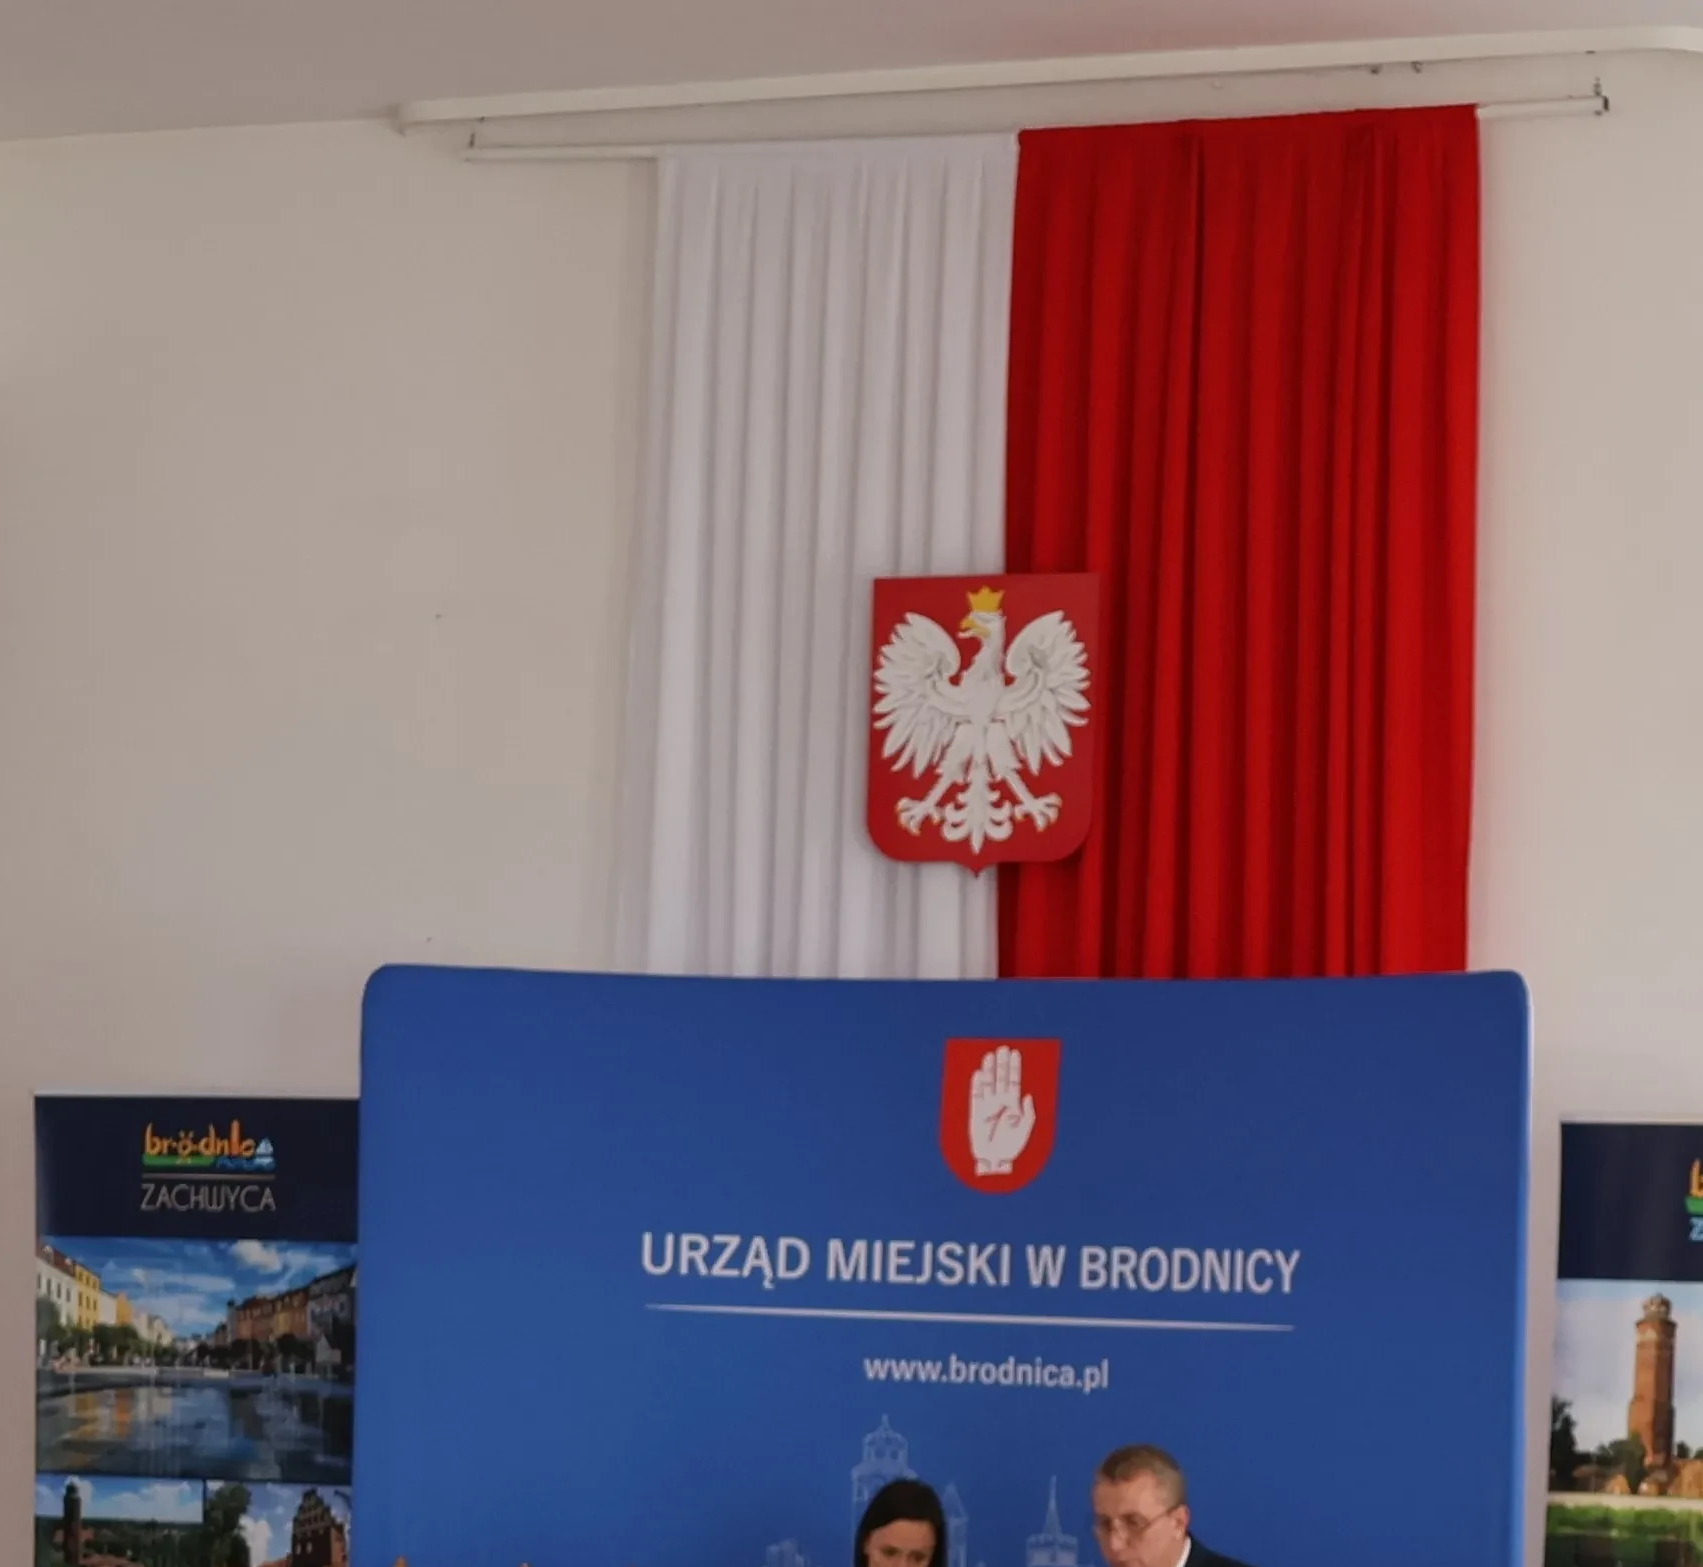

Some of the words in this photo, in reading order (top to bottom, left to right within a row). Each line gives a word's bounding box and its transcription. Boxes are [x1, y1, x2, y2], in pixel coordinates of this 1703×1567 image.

[140, 1183, 276, 1212] ZACHWYCA
[641, 1231, 811, 1289] URZĄD
[826, 1238, 1011, 1287] MIEJSKI
[1026, 1245, 1067, 1288] W
[1080, 1246, 1301, 1294] BRODNICY
[864, 1353, 1109, 1393] www.brodnica.pl
